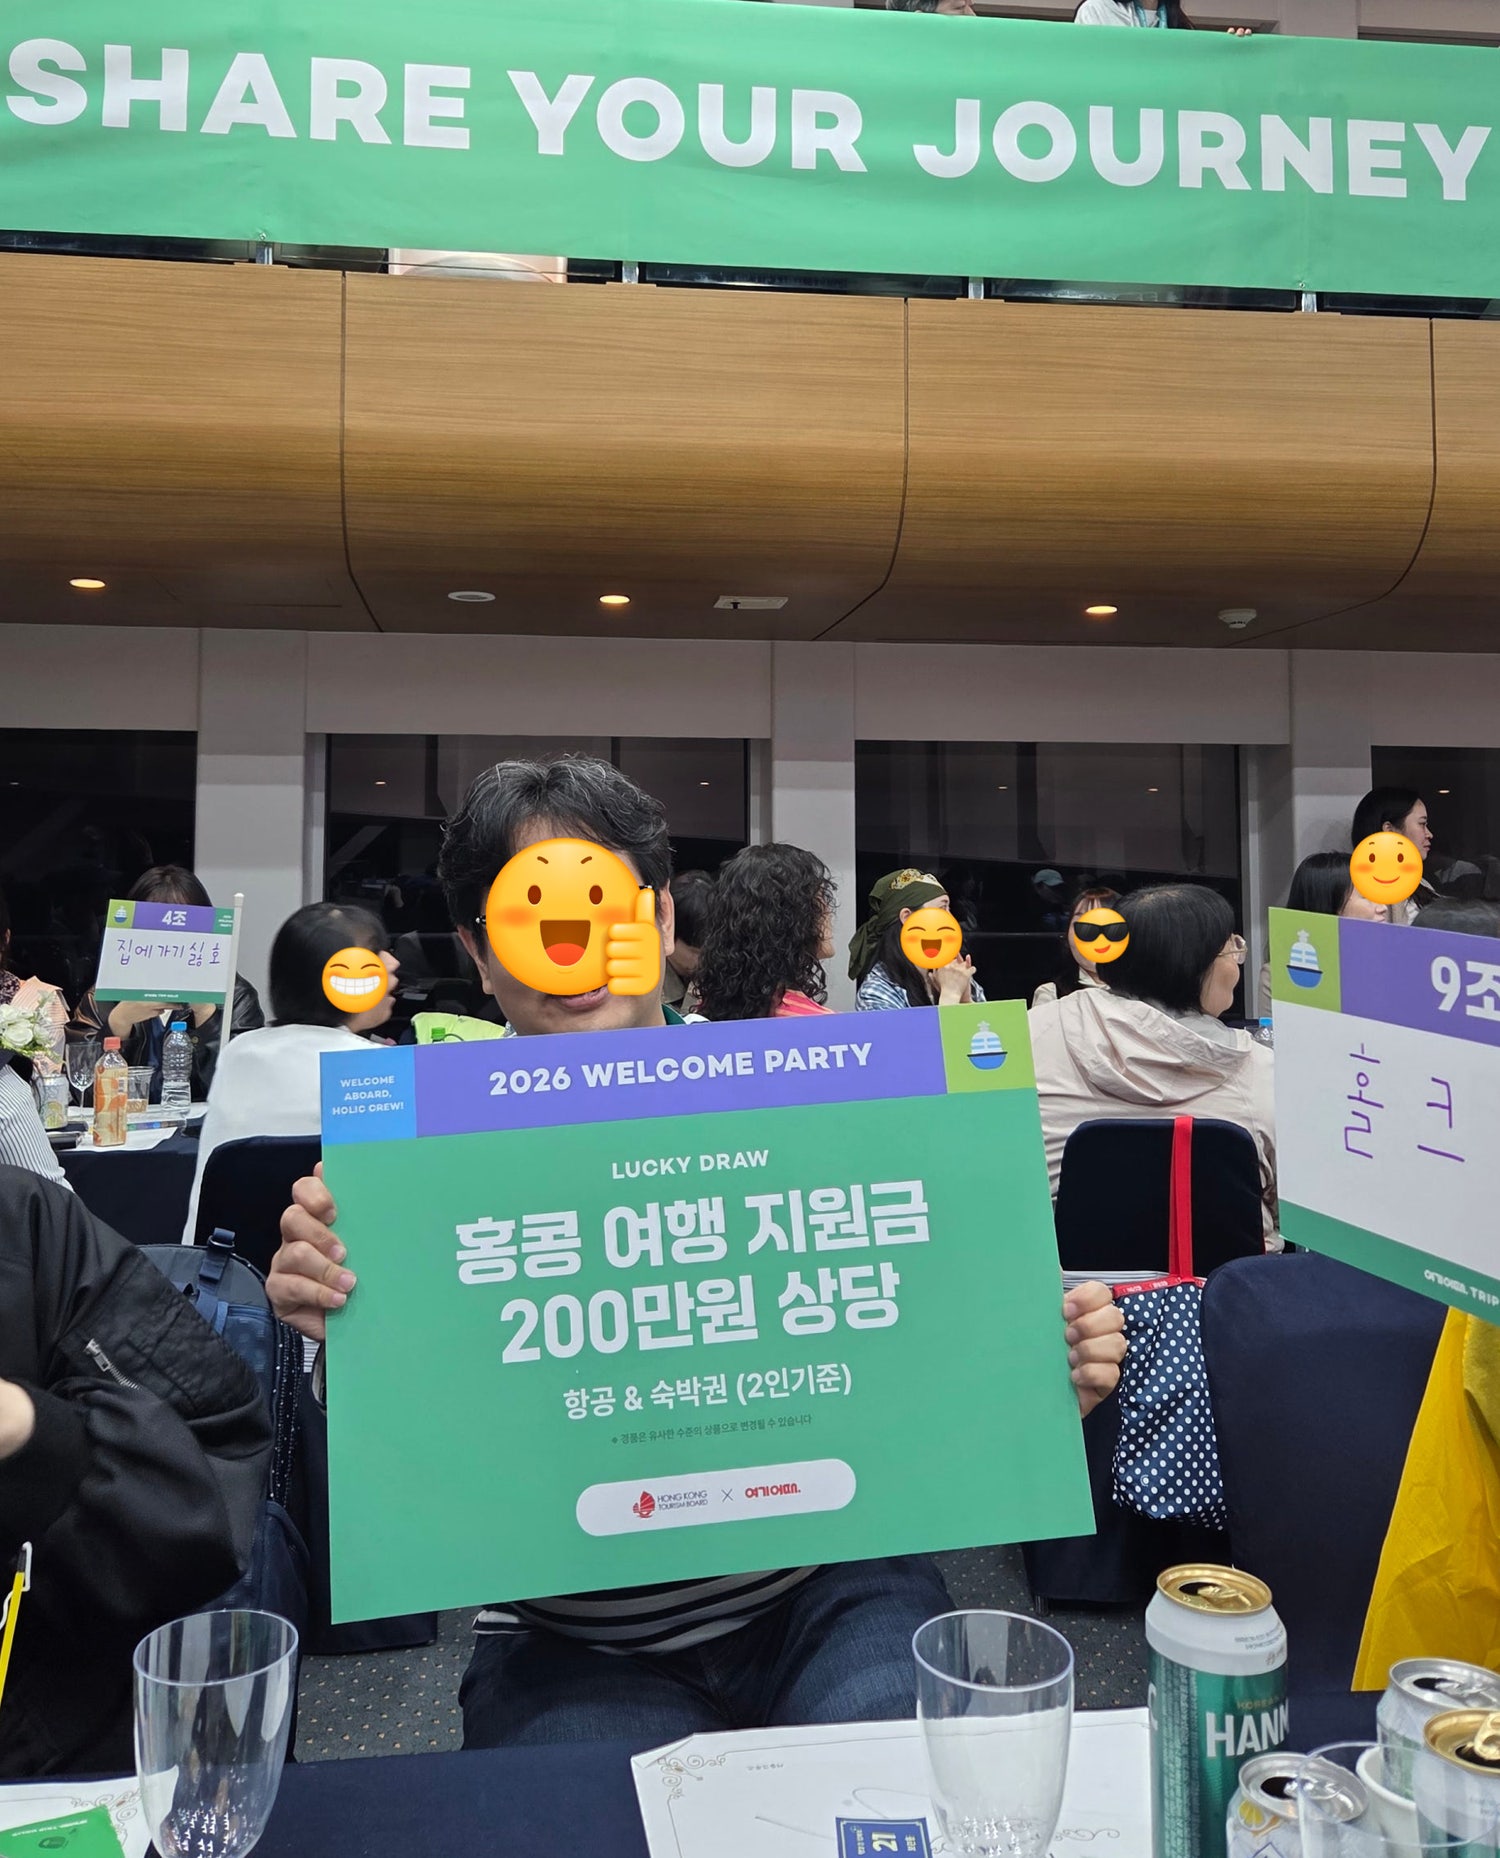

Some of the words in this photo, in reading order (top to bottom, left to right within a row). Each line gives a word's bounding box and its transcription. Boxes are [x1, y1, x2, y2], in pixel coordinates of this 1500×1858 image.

[5, 38, 471, 149] SHARE
[507, 70, 868, 173] YOUR
[912, 98, 1492, 201] JOURNEY
[162, 910, 187, 926] 4조
[1431, 956, 1500, 1022] 9조
[340, 1075, 395, 1087] WELCOME
[489, 1066, 571, 1096] 2026
[581, 1051, 754, 1088] WELCOME
[765, 1042, 873, 1073] PARTY
[332, 1104, 366, 1115] HOLIC
[368, 1101, 404, 1112] CREW!
[611, 1156, 691, 1180] LUCKY
[699, 1150, 769, 1172] DRAW
[455, 1210, 581, 1285] 홍콩
[603, 1196, 728, 1269] 여행
[744, 1179, 931, 1256] 지원금
[1469, 1286, 1500, 1306] TRIP
[500, 1274, 759, 1364] 200만원
[778, 1261, 901, 1337] 상당
[563, 1386, 616, 1420] 항공
[624, 1386, 643, 1411] &
[650, 1373, 728, 1410] 숙박권
[736, 1362, 852, 1406] (2인기준)
[704, 1422, 738, 1435] 상품으로
[768, 1418, 776, 1428] 수
[778, 1414, 811, 1427] 있습니다
[657, 1492, 682, 1502] HONG
[683, 1490, 708, 1499] KONG
[872, 1832, 898, 1852] 21
